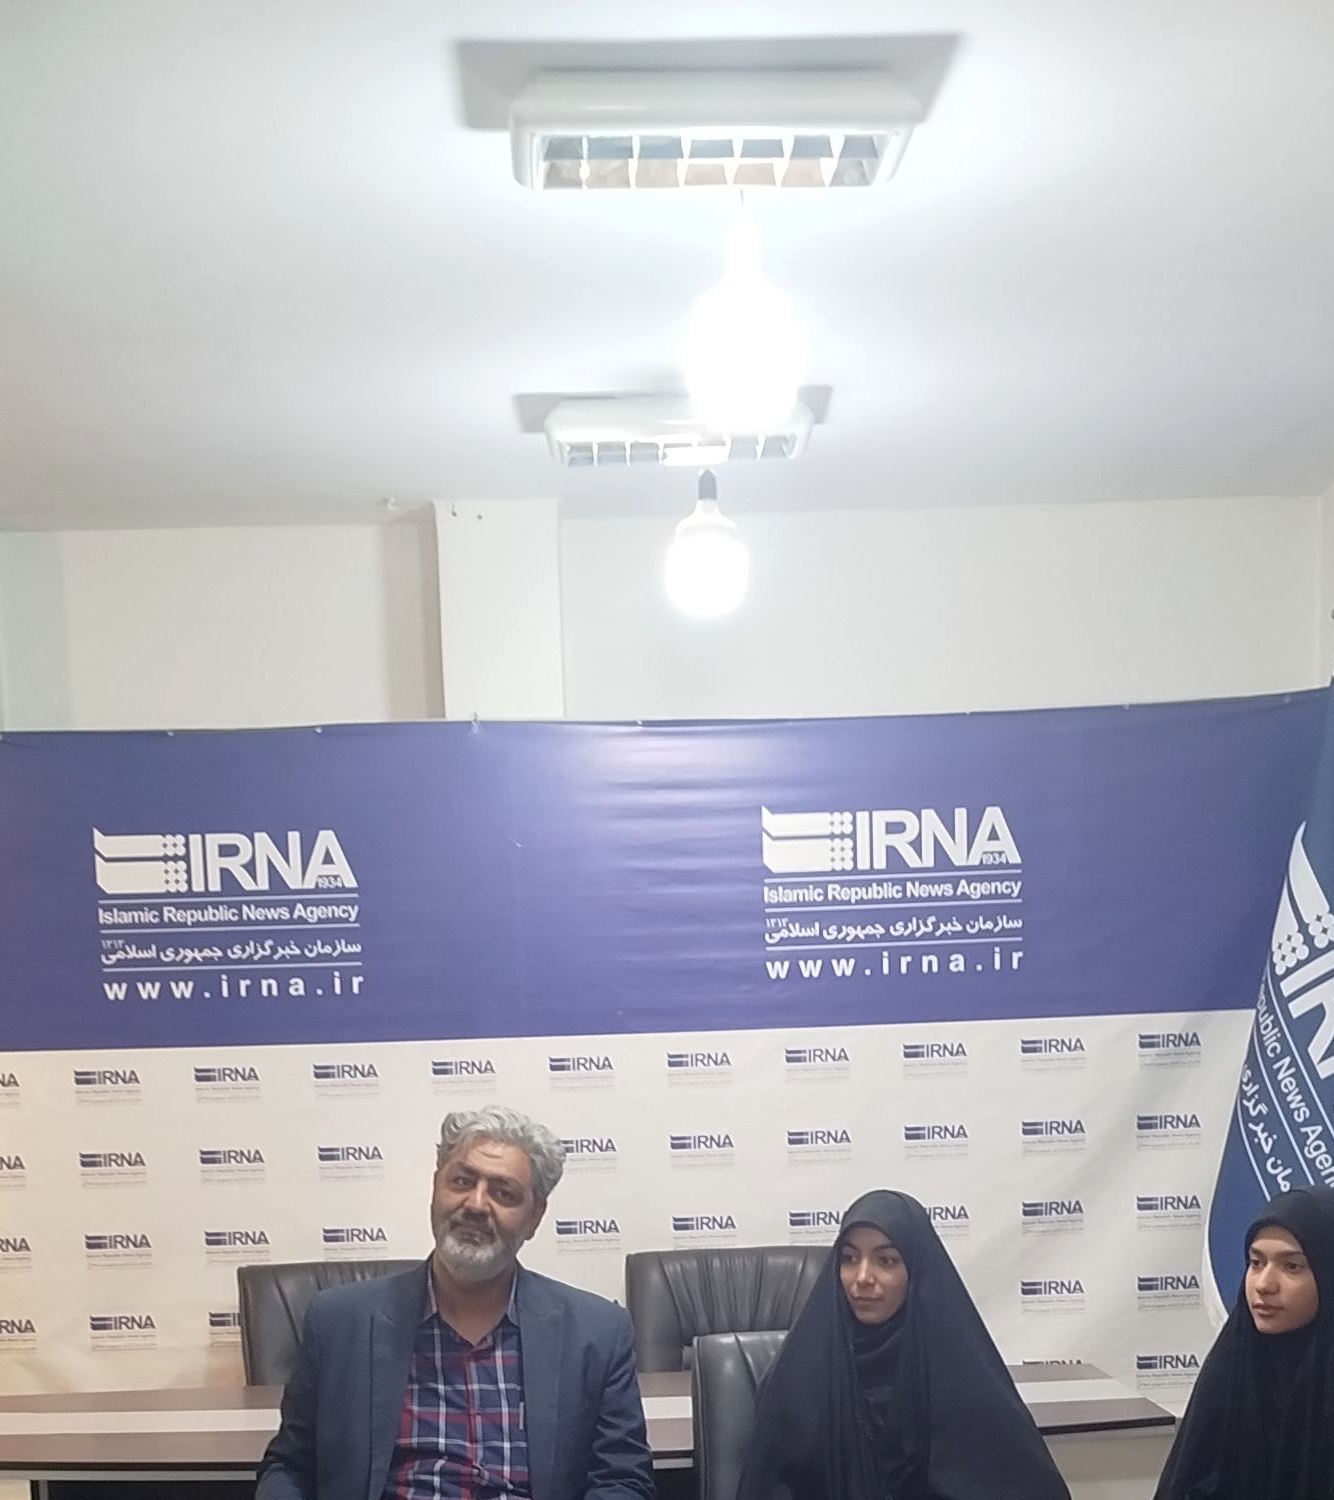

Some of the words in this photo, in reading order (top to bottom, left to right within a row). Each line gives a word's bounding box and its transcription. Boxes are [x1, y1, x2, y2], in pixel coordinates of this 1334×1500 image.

[856, 806, 1022, 870] IRNA
[189, 829, 358, 892] IRNA
[764, 885, 824, 904] Islamic
[828, 882, 902, 903] Republic
[907, 880, 954, 898] News
[956, 879, 1022, 900] Agency
[98, 906, 160, 924] Islamic
[163, 905, 239, 925] Republic
[242, 904, 290, 921] News
[293, 903, 359, 922] Agency
[764, 921, 820, 944] اسلامی
[823, 921, 885, 942] جمهوری
[966, 914, 1023, 934] سازمان
[100, 943, 156, 965] اسلامی
[160, 945, 222, 964] جمهوری
[304, 938, 362, 957] سازمان
[766, 946, 1023, 979] www.irna.ir
[103, 971, 364, 1000] www.irna.ir
[1043, 1037, 1086, 1054] IRNA
[1161, 1031, 1202, 1049] IRNA
[807, 1047, 850, 1064] IRNA
[925, 1042, 968, 1059] IRNA
[453, 1059, 496, 1076] IRNA
[571, 1055, 614, 1072] IRNA
[689, 1051, 732, 1068] IRNA
[96, 1069, 141, 1086] IRNA
[217, 1066, 260, 1083] IRNA
[336, 1063, 379, 1081] IRNA
[1272, 1056, 1310, 1123] News
[1044, 1119, 1086, 1136] IRNA
[1159, 1113, 1202, 1130] IRNA
[809, 1129, 852, 1145] IRNA
[926, 1124, 969, 1141] IRNA
[575, 1138, 617, 1153] IRNA
[692, 1133, 735, 1150] IRNA
[102, 1151, 147, 1168] IRNA
[222, 1148, 266, 1165] IRNA
[341, 1145, 384, 1162] IRNA
[1043, 1199, 1084, 1217] IRNA
[1160, 1195, 1202, 1211] IRNA
[578, 1219, 621, 1235] IRNA
[694, 1215, 737, 1232] IRNA
[812, 1211, 841, 1226] IRN
[108, 1233, 152, 1250] IRNA
[227, 1230, 271, 1247] IRNA
[345, 1227, 388, 1243] IRNA
[1043, 1279, 1085, 1296] IRNA
[1159, 1274, 1202, 1292] IRNA
[113, 1314, 157, 1331] IRNA
[1159, 1354, 1200, 1369] IRNA
